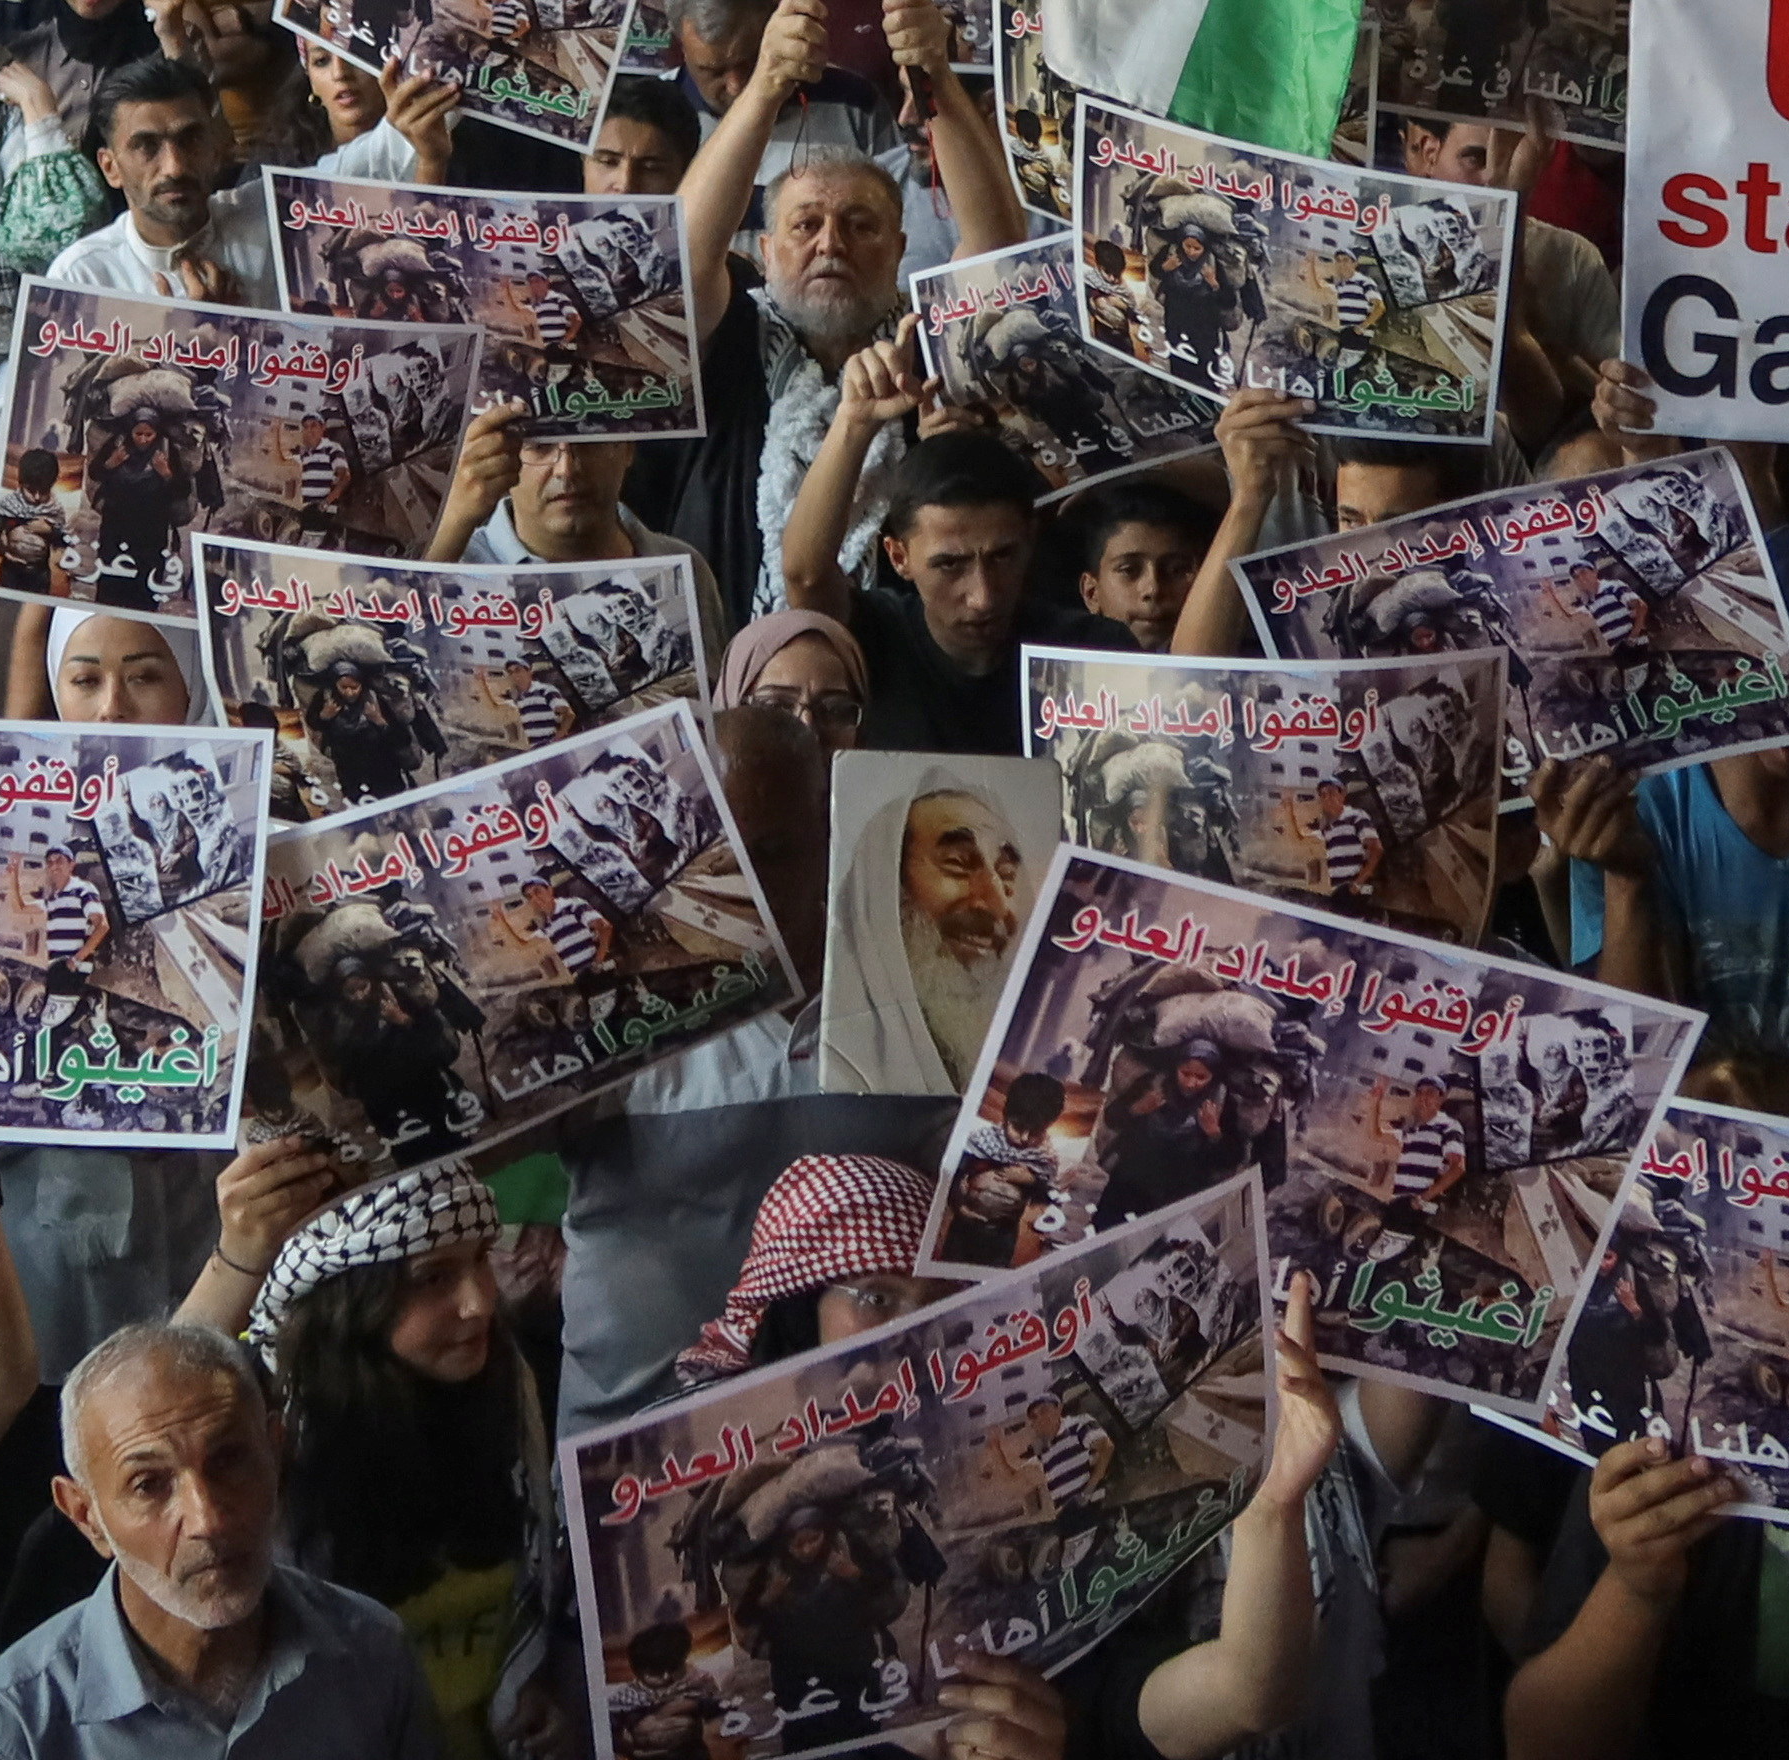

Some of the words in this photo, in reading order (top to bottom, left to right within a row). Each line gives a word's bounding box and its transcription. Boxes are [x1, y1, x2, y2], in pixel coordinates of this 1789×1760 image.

[476, 62, 594, 122] أغيثوا
[1089, 135, 1178, 180] العدو
[282, 196, 369, 230] العدو
[1185, 164, 1275, 213] إمداد
[1280, 185, 1392, 237] أوقفوا
[375, 206, 460, 248] إمداد
[467, 211, 571, 255] أوقفوا
[27, 314, 132, 358] العدو
[140, 329, 241, 382] إمداد
[1135, 311, 1202, 368] غزة
[248, 338, 365, 395] أوقفوا
[1331, 366, 1478, 419] أغيثوا
[545, 374, 685, 423] أغيثوا
[1482, 483, 1609, 559] أوقفوا
[57, 532, 139, 584] غزة
[146, 548, 185, 603] في
[1379, 522, 1482, 579] إمداد
[214, 573, 312, 619] العدو
[324, 585, 425, 633] إمداد
[1269, 553, 1370, 615] العدو
[429, 588, 555, 640] أوقفوا
[1034, 683, 1120, 741] العدو
[1129, 693, 1235, 750] إمداد
[1245, 687, 1380, 756] أوقفوا
[424, 780, 562, 879] أوقفوا
[310, 832, 420, 909] إمداد
[1052, 904, 1211, 967] العدو
[1216, 938, 1357, 1018] إمداد
[1360, 984, 1524, 1056] أوقفوا
[36, 1023, 222, 1104] أغيثوا
[1348, 1258, 1556, 1352] أغيثوا
[929, 1278, 1095, 1404] أوقفوا
[772, 1360, 916, 1458] إمداد
[599, 1420, 757, 1526] العدو
[718, 1682, 842, 1740] غزة
[859, 1654, 912, 1716] في
